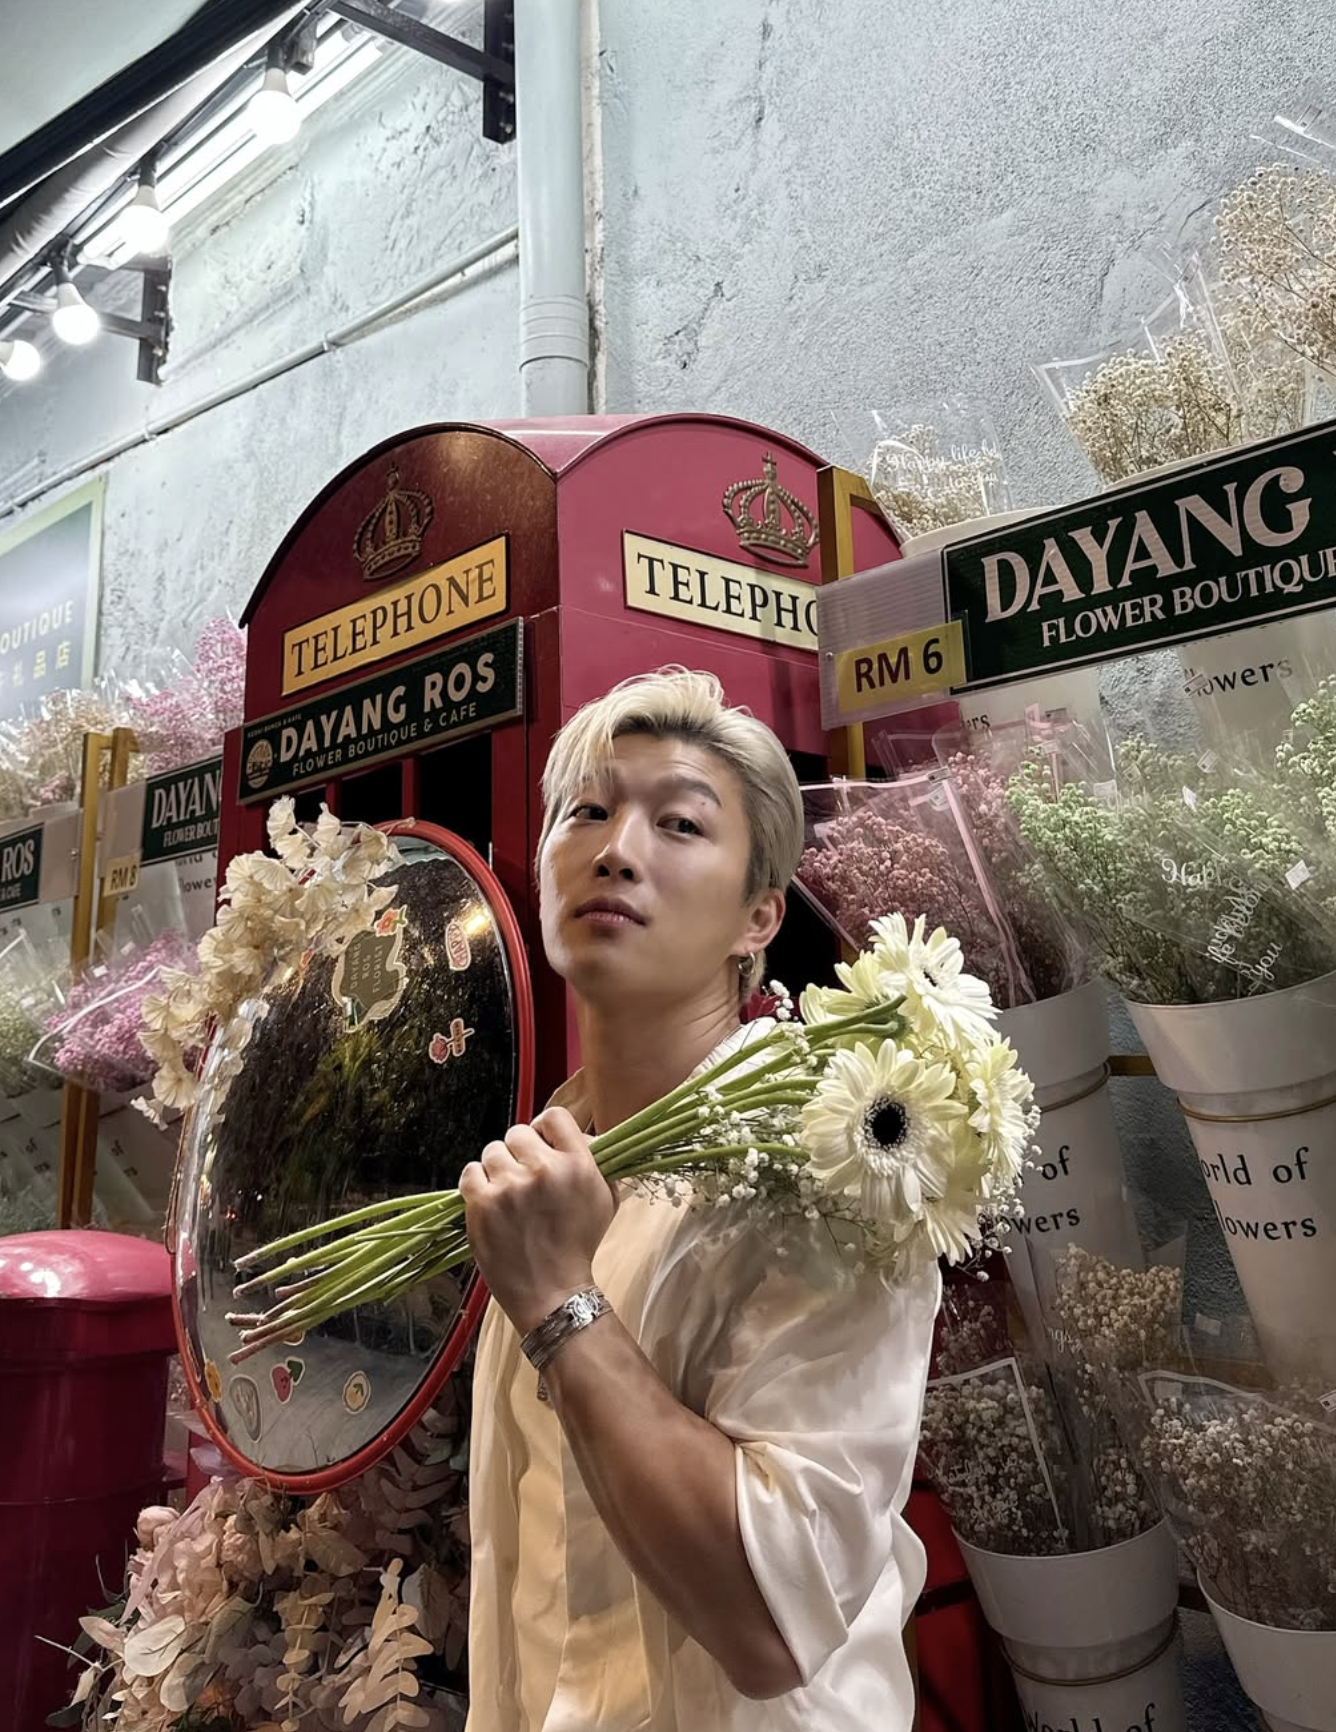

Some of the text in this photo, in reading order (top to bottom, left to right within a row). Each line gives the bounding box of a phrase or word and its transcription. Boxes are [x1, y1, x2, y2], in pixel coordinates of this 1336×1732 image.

[981, 467, 1312, 624] DAYANG
[291, 559, 496, 678] TELEPHONE
[1041, 593, 1166, 648] FLOWER
[855, 638, 943, 693] RM 6
[280, 652, 495, 763] DAYANG ROS
[292, 749, 342, 777] FLOWER
[348, 722, 418, 759] BOUTIQUE
[424, 718, 433, 732] &
[439, 702, 477, 727] CAFE
[2, 839, 34, 882] ROS
[110, 867, 128, 891] RM
[1250, 943, 1283, 980] you
[1042, 1145, 1070, 1180] of
[1273, 1146, 1309, 1183] of
